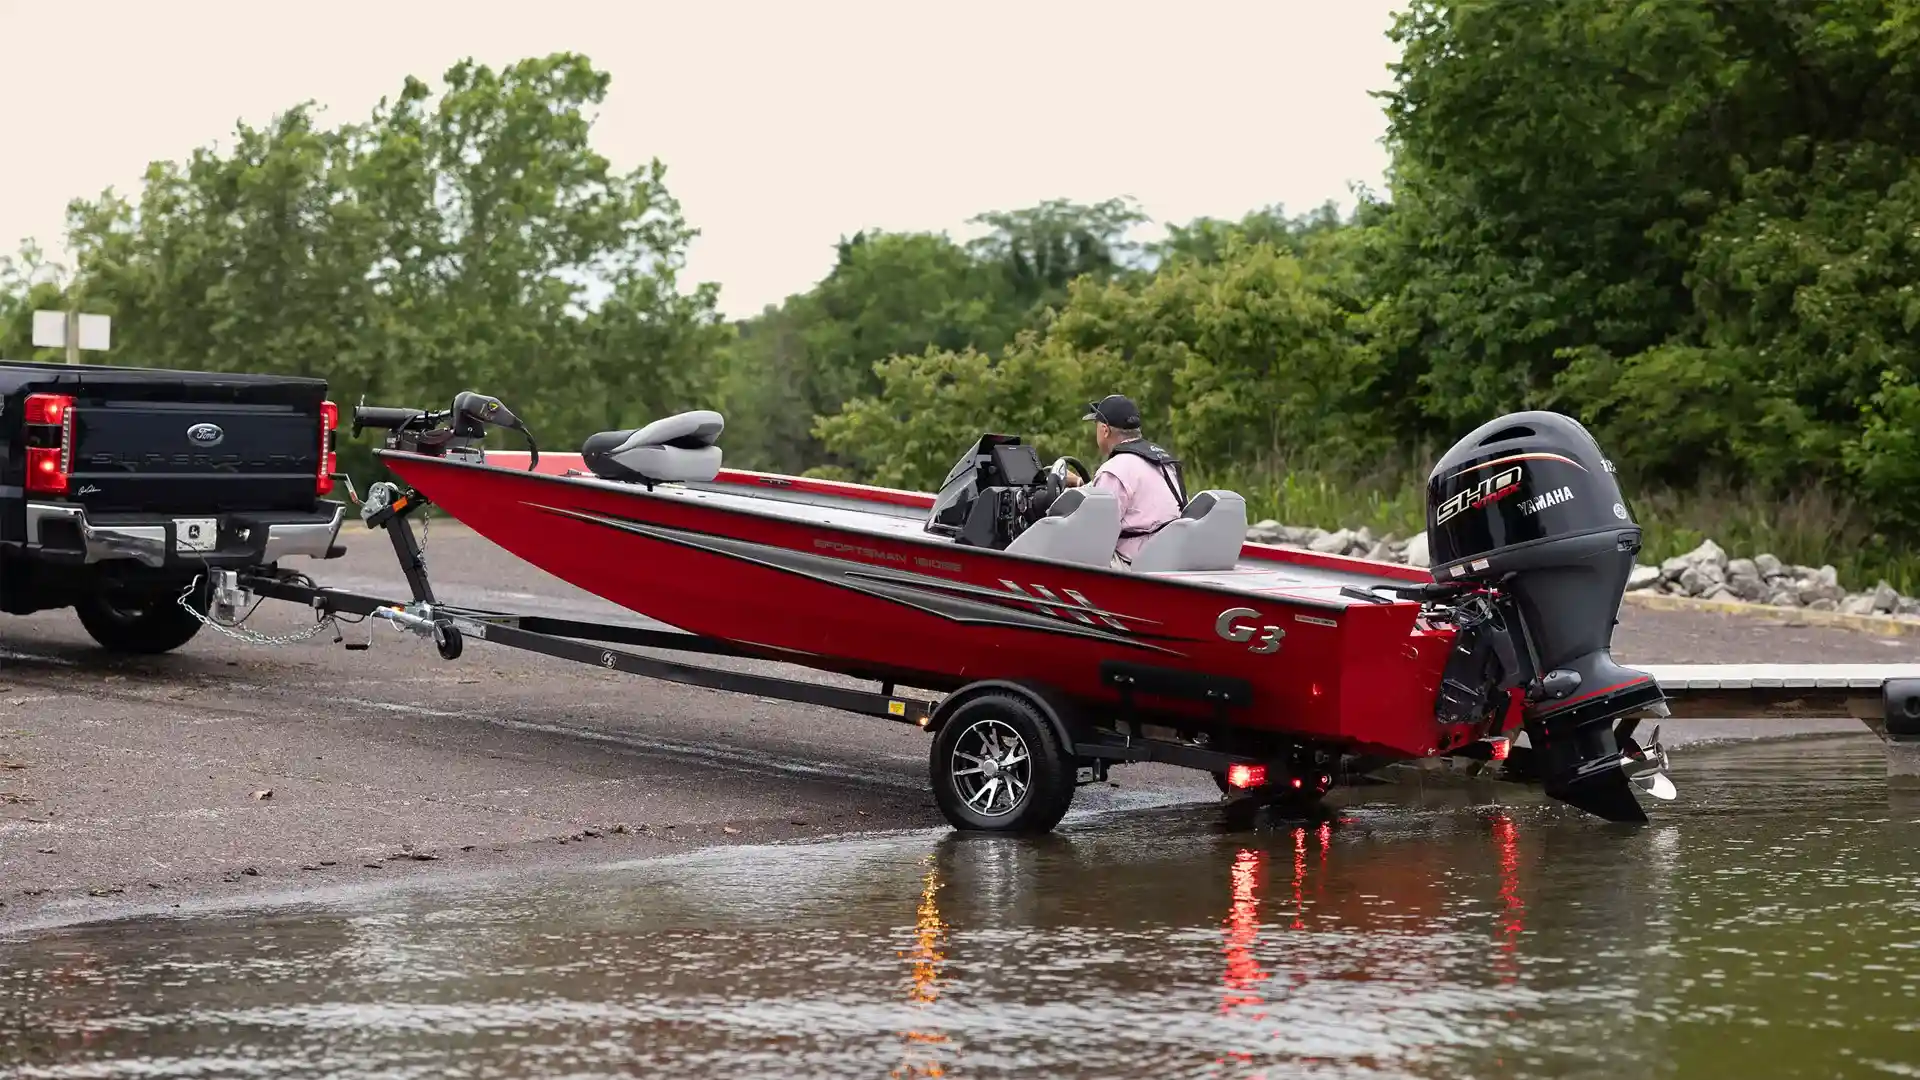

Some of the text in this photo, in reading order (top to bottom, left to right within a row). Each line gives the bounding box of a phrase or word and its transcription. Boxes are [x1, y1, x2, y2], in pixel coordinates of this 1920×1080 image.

[1437, 466, 1523, 526] SHO
[1517, 486, 1575, 516] YAMAHA
[813, 539, 907, 564] SPORTSMAN
[1215, 607, 1286, 654] G3
